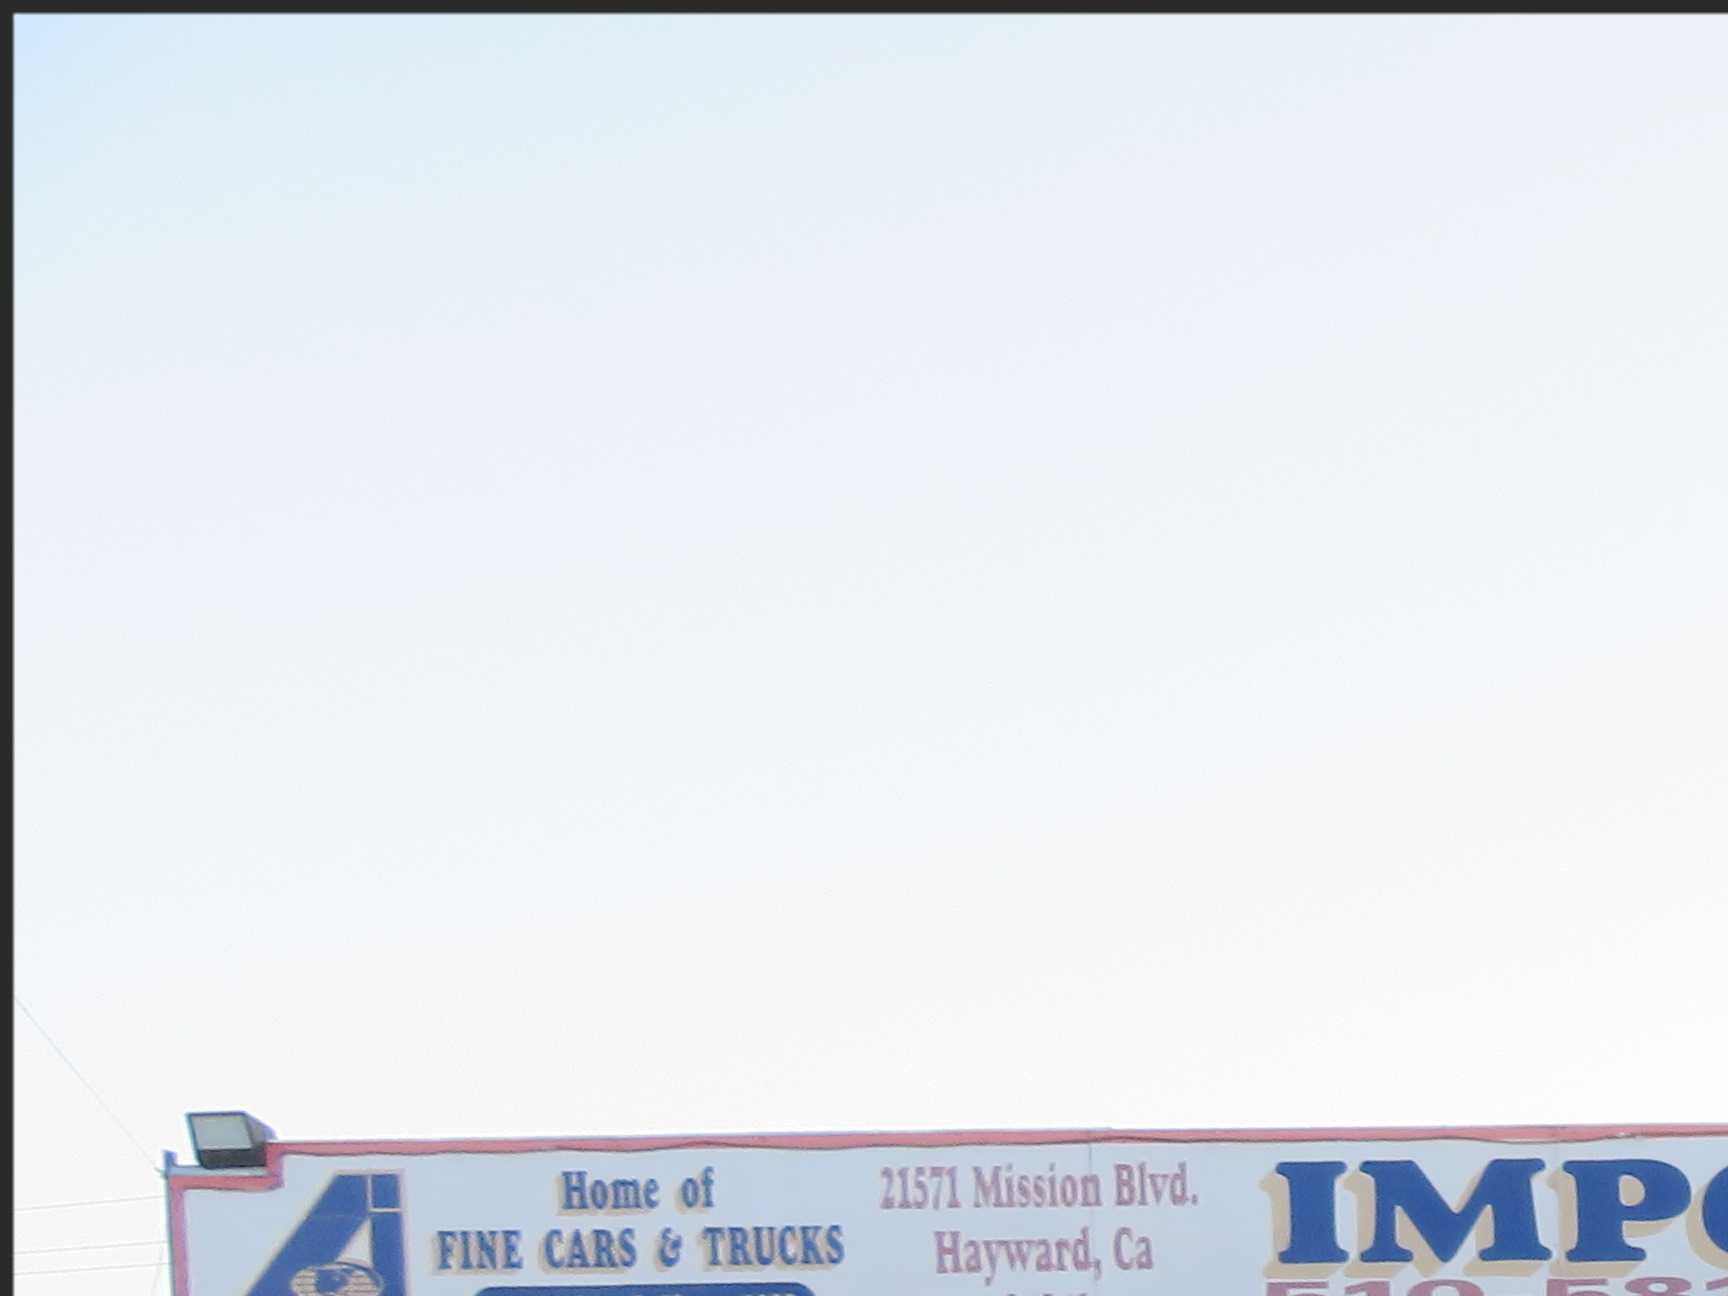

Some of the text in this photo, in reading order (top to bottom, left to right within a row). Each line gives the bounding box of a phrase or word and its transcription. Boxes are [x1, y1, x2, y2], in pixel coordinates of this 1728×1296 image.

[560, 1167, 716, 1211] Home of
[880, 1162, 1199, 1210] 21571 Mission Blvd.
[437, 1224, 845, 1270] FINE CARS & TRUCKS
[934, 1226, 1155, 1285] Hayward, Ca
